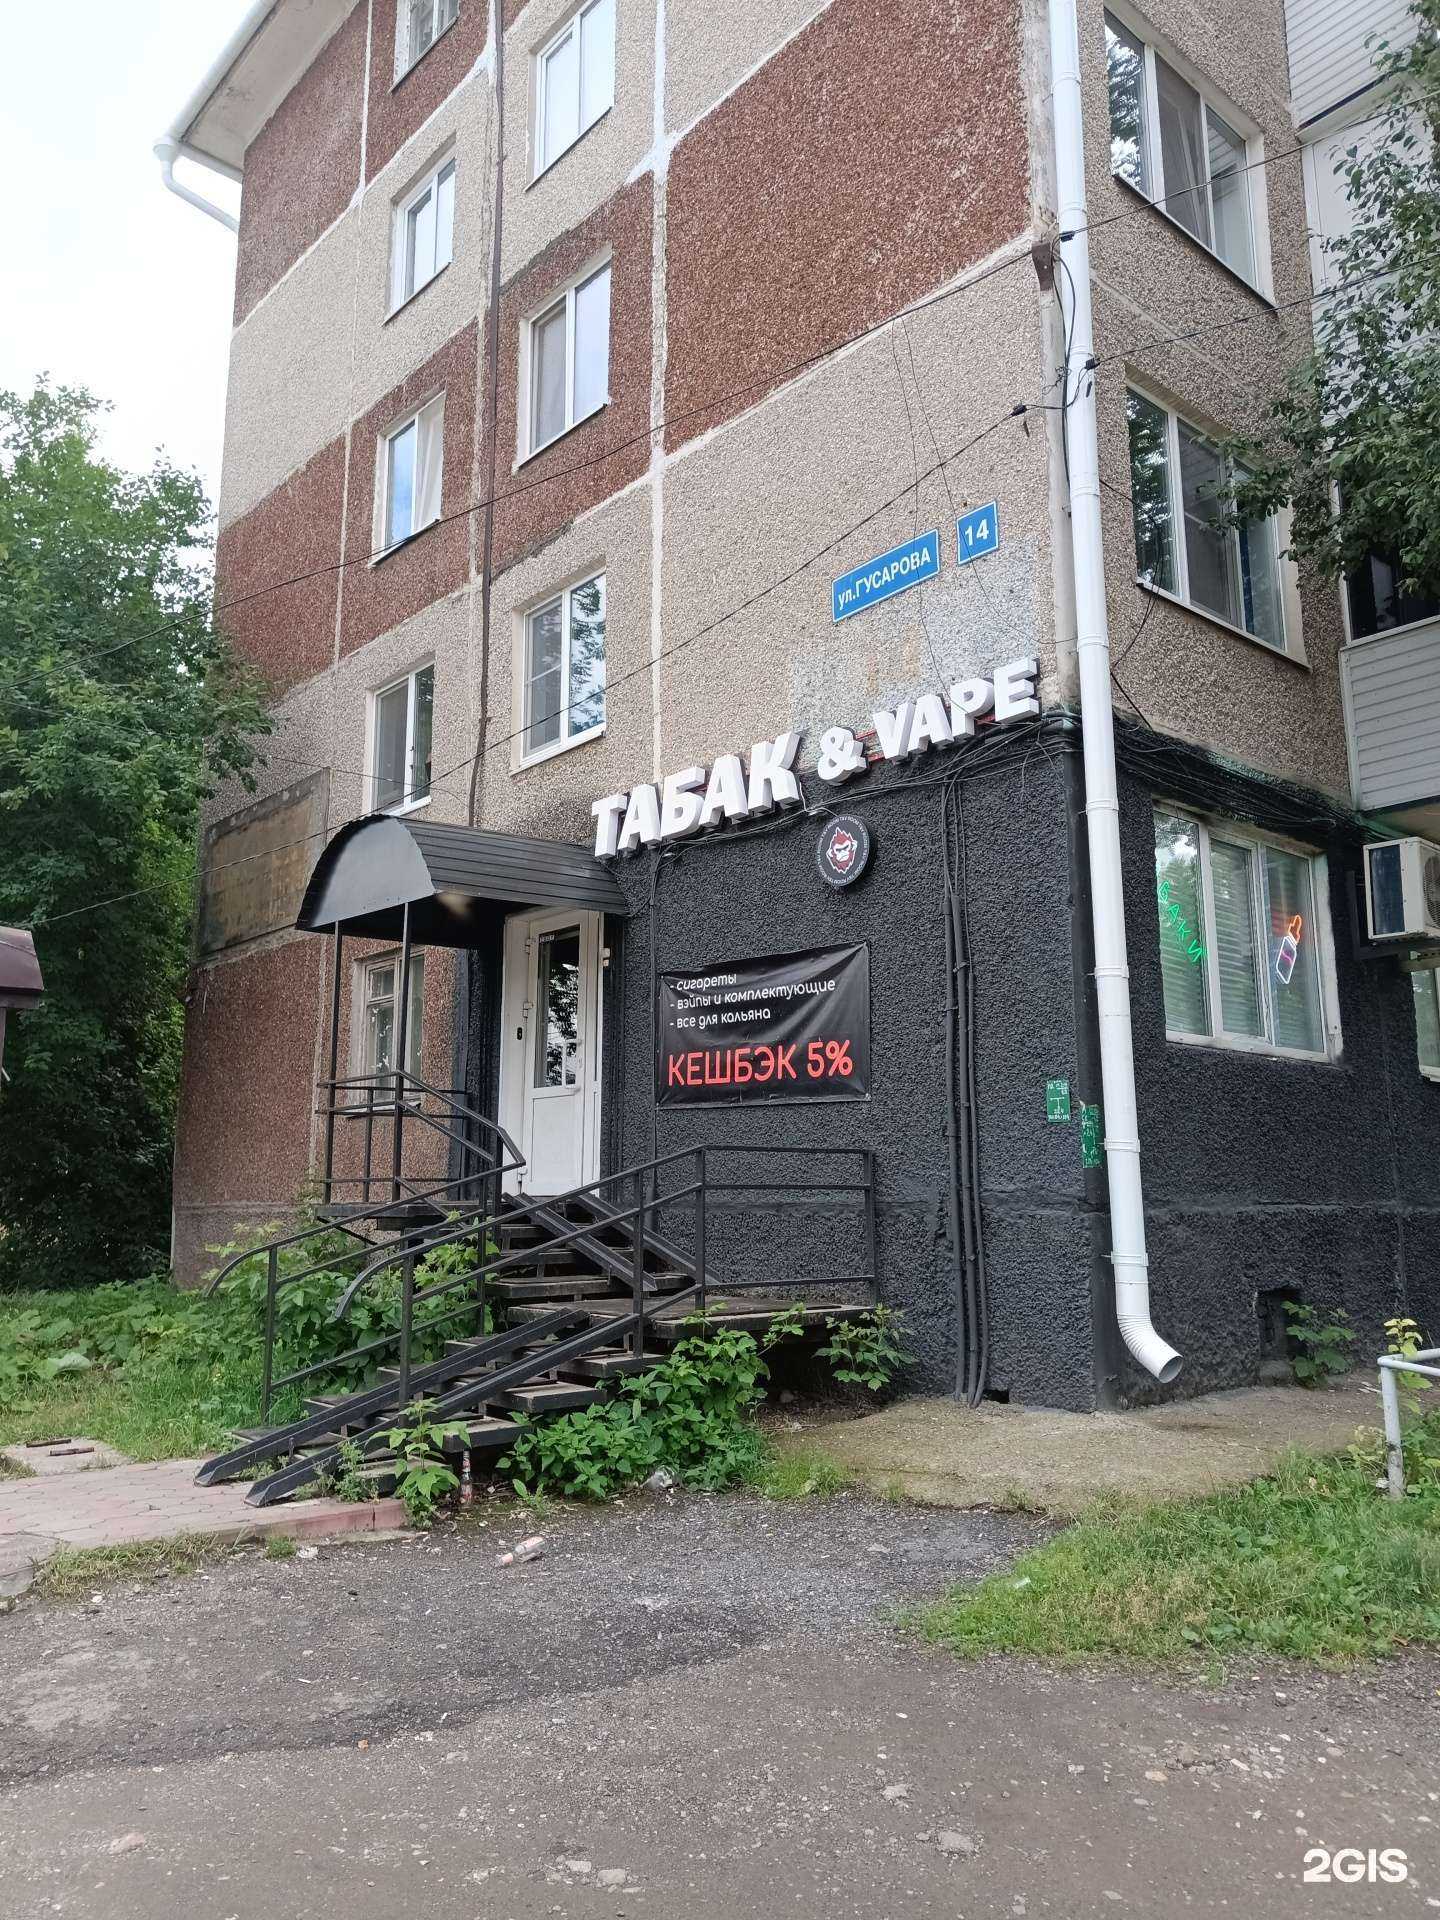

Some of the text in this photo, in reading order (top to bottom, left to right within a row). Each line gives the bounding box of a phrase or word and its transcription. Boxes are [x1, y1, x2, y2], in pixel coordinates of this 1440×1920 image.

[964, 518, 990, 546] 14
[591, 732, 801, 859] ТАБАК
[817, 726, 868, 785] &
[872, 657, 1041, 762] VAPE
[676, 973, 737, 991] сигареты
[677, 993, 711, 1010] вэйпы
[714, 994, 722, 1005] и
[724, 979, 836, 1004] комплектующие
[676, 1017, 697, 1029] все
[698, 1013, 719, 1030] для
[721, 1008, 771, 1024] кальяна
[668, 1039, 854, 1087] КЕШБЭК 5%
